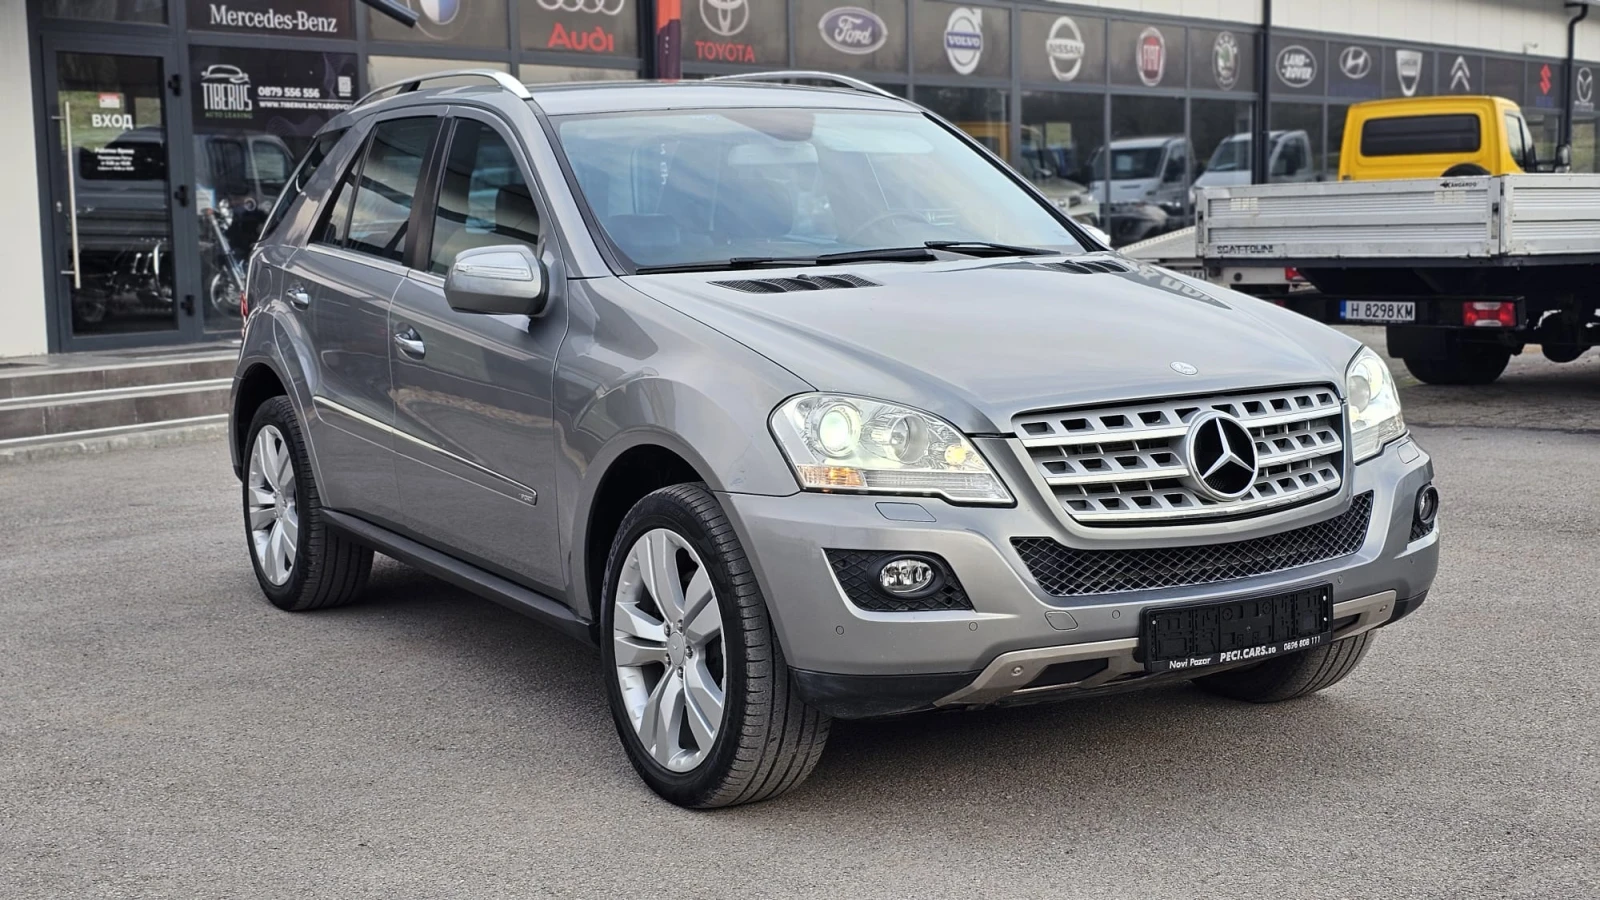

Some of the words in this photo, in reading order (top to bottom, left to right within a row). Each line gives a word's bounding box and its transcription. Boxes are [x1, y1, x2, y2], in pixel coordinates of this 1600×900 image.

[209, 4, 337, 32] Mercedes-Benz
[834, 15, 873, 45] Ford
[548, 22, 614, 51] Audi
[947, 34, 981, 47] VOLVO
[1048, 43, 1083, 55] NISSAN
[695, 40, 756, 63] TOYOTA
[1143, 44, 1161, 71] FIAT
[201, 83, 252, 111] TIBERUS
[258, 86, 282, 97] 0879
[284, 87, 302, 98] 556
[303, 88, 320, 99] 556
[92, 114, 134, 131] ВХОД
[1350, 302, 1360, 318] H
[1364, 302, 1395, 319] 8298
[1396, 303, 1414, 319] KM
[1169, 659, 1189, 669] Novi
[1189, 656, 1212, 667] Pazar
[1311, 635, 1321, 645] 111
